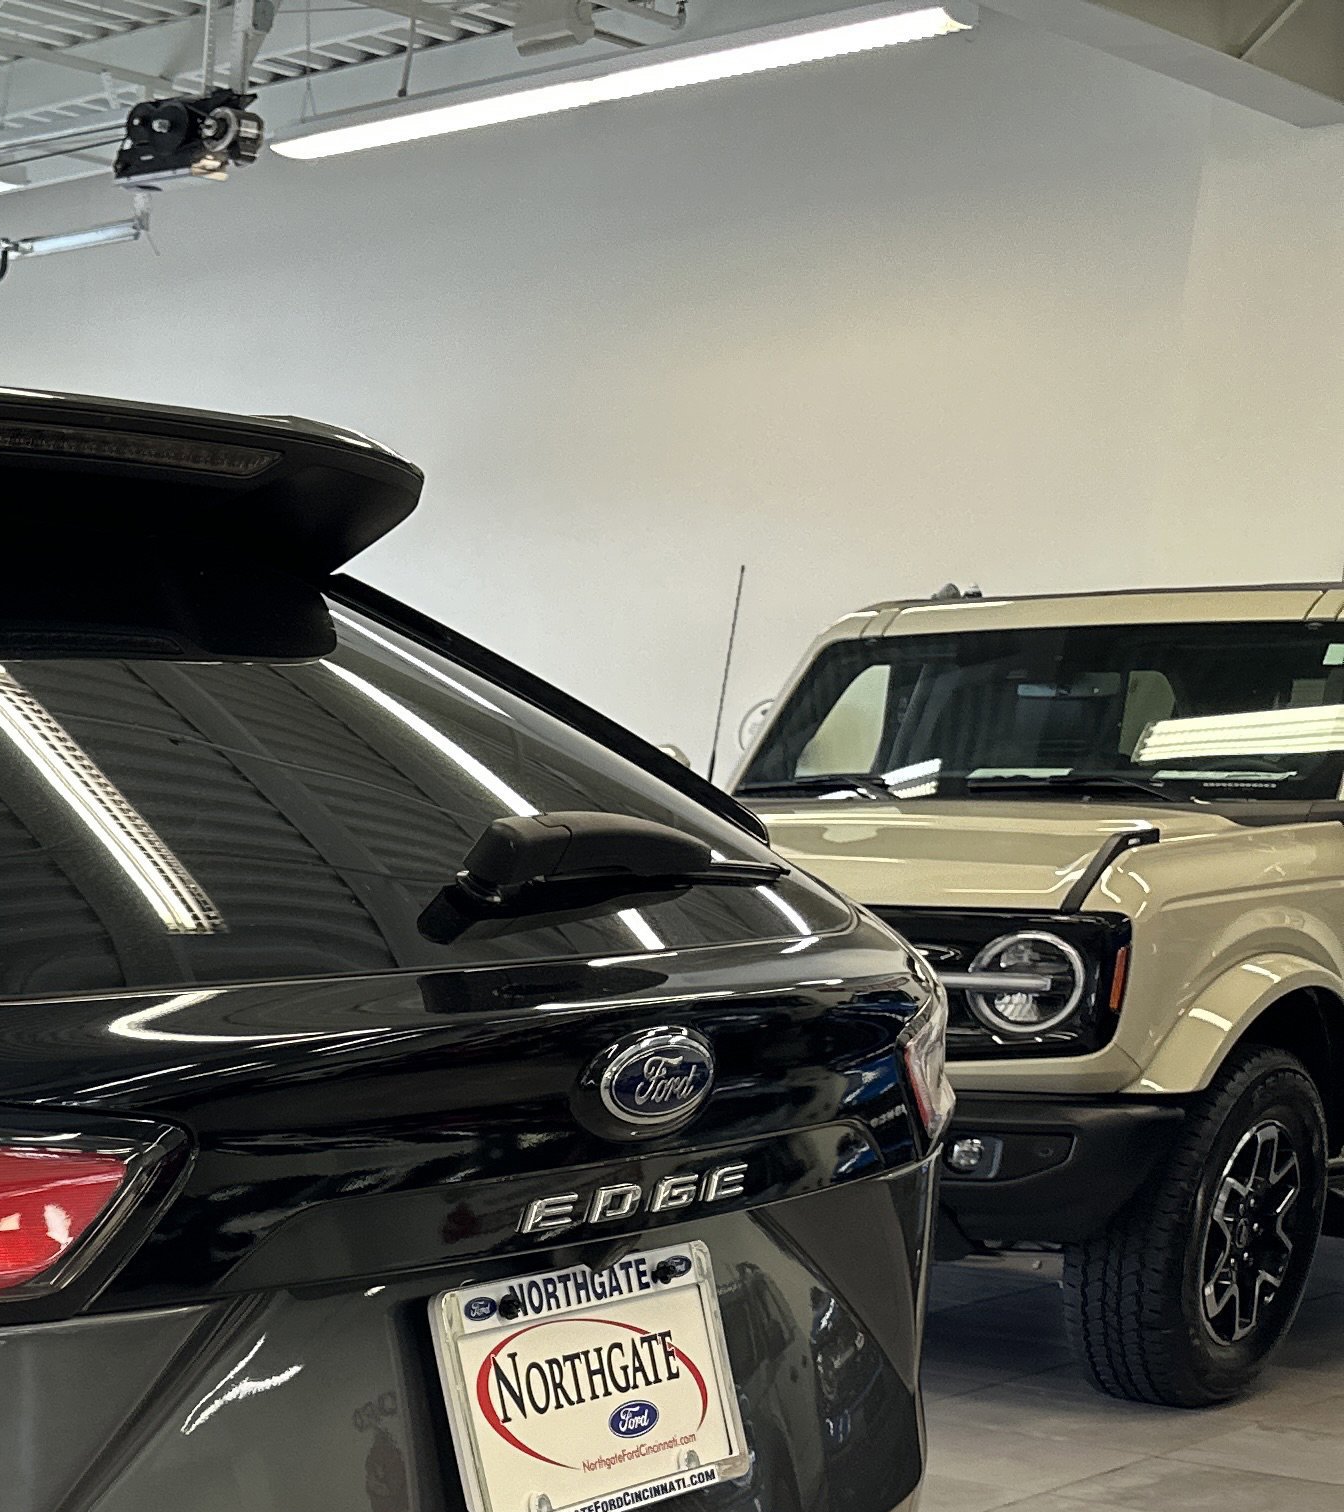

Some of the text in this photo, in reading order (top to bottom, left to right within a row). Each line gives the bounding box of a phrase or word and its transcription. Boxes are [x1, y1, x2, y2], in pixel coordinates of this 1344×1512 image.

[634, 1055, 699, 1106] Ford
[514, 1163, 748, 1234] EDGE
[508, 1257, 651, 1317] NORTHGATE
[492, 1329, 680, 1424] NORTHGATE
[618, 1405, 650, 1432] Ford
[581, 1432, 697, 1474] NorthgateFordCincinnati.com
